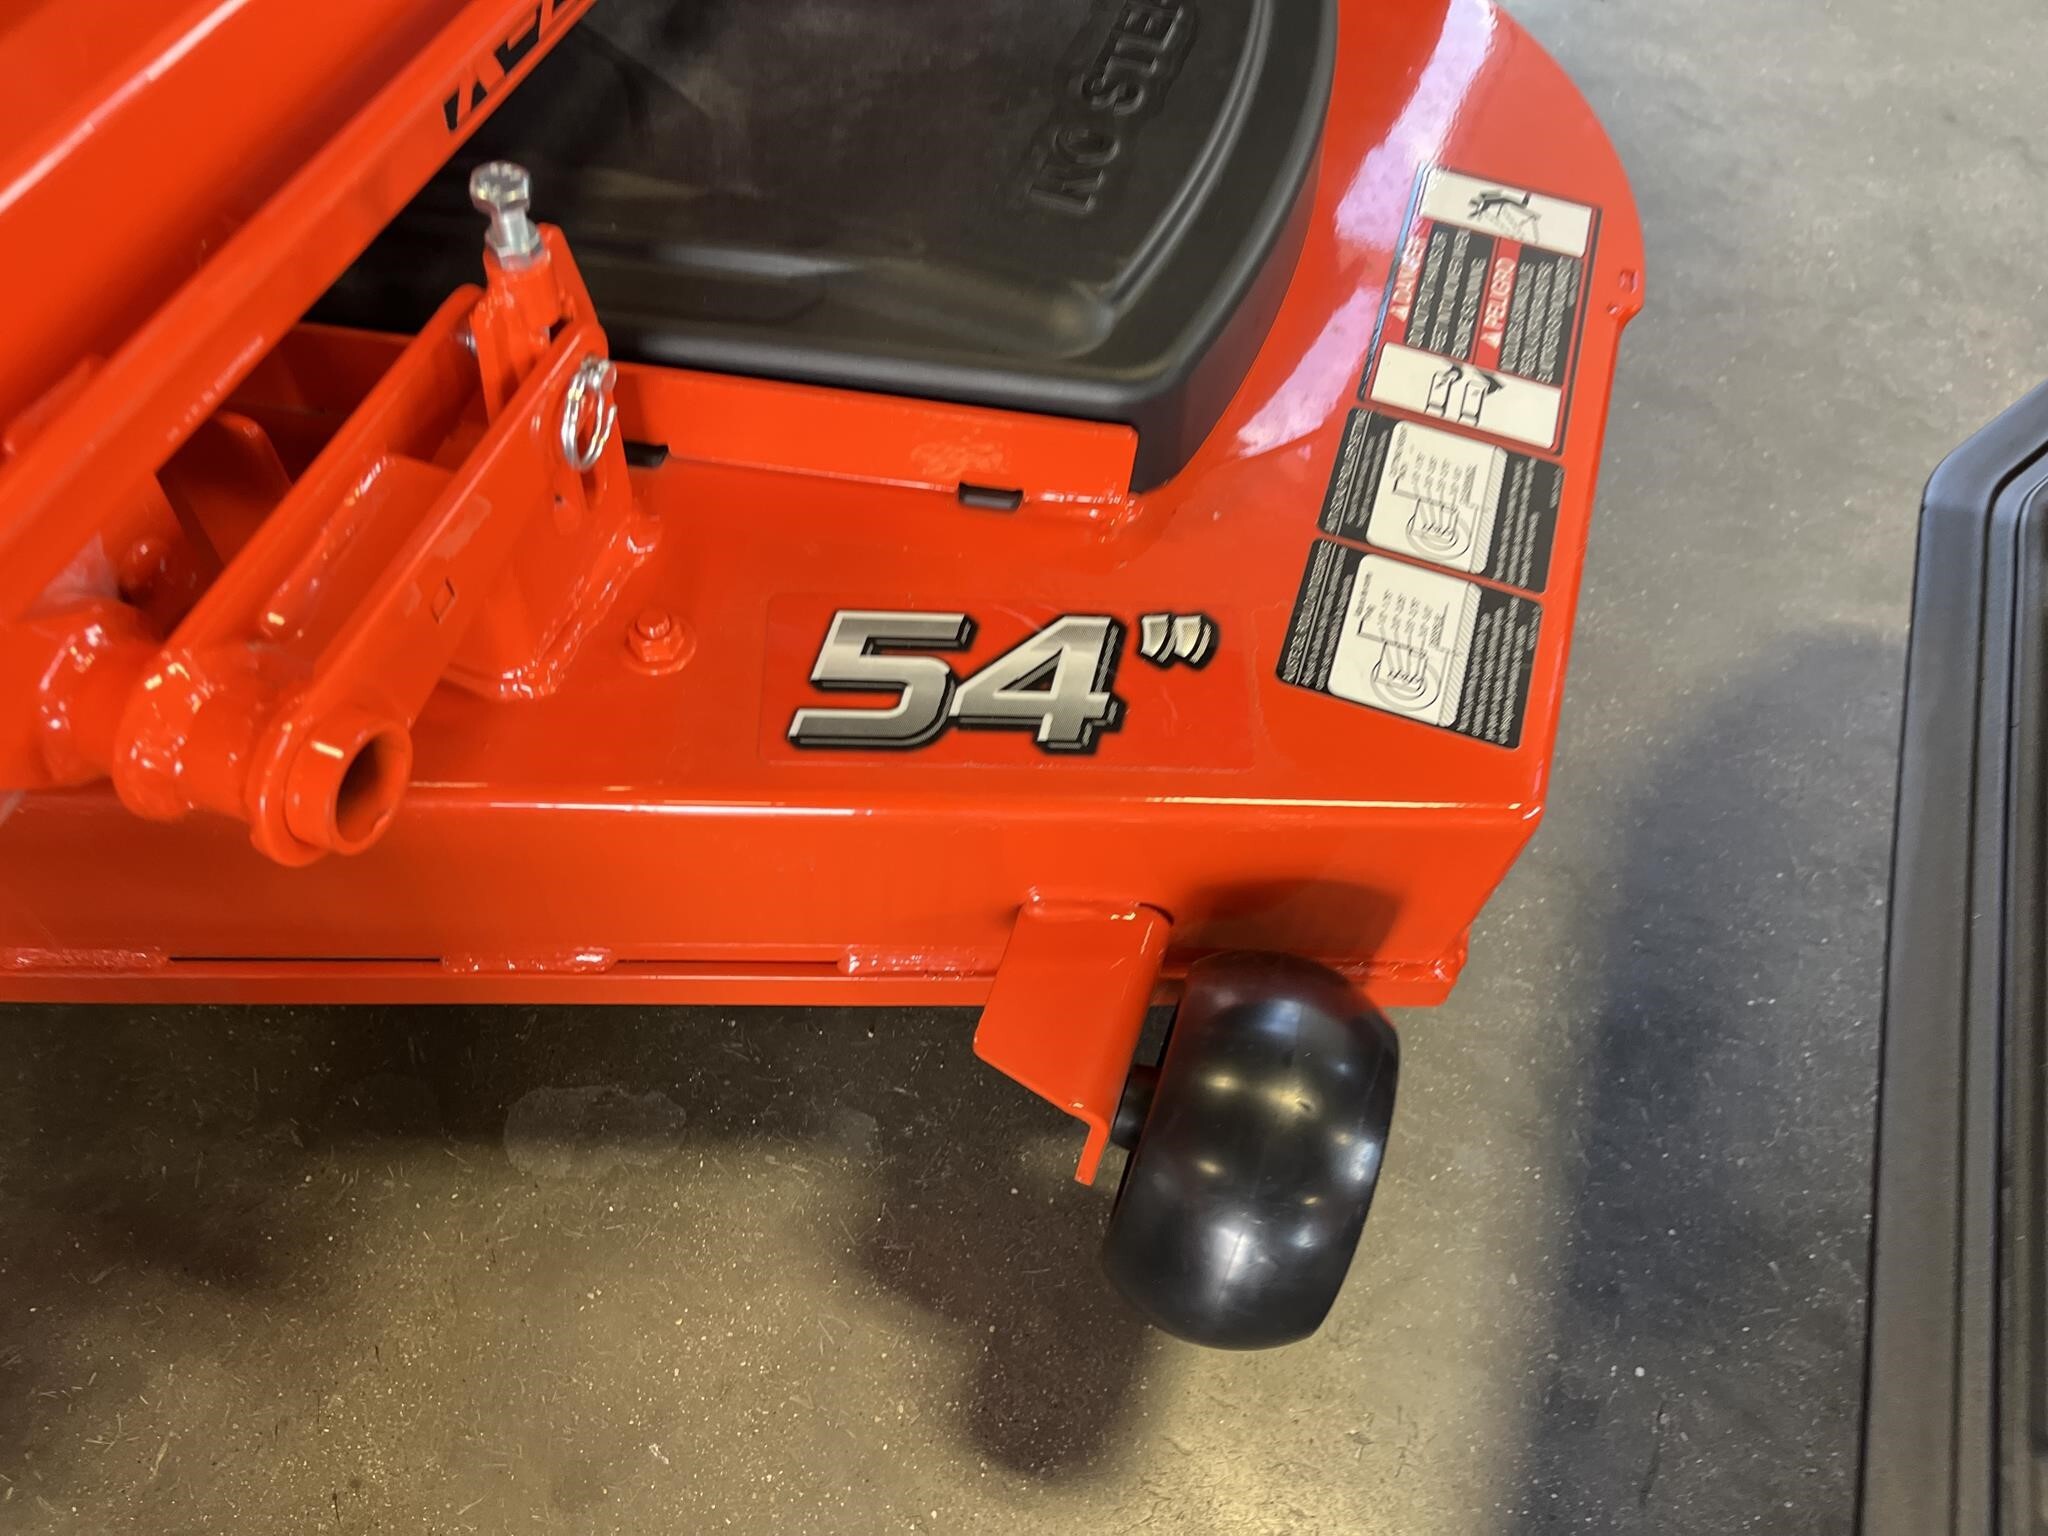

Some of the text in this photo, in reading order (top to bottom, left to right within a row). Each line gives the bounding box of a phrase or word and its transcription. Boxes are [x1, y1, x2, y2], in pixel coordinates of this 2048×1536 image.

[1083, 0, 1185, 115] STE
[1482, 255, 1517, 331] PELIGRO
[787, 608, 1220, 755] 54"
